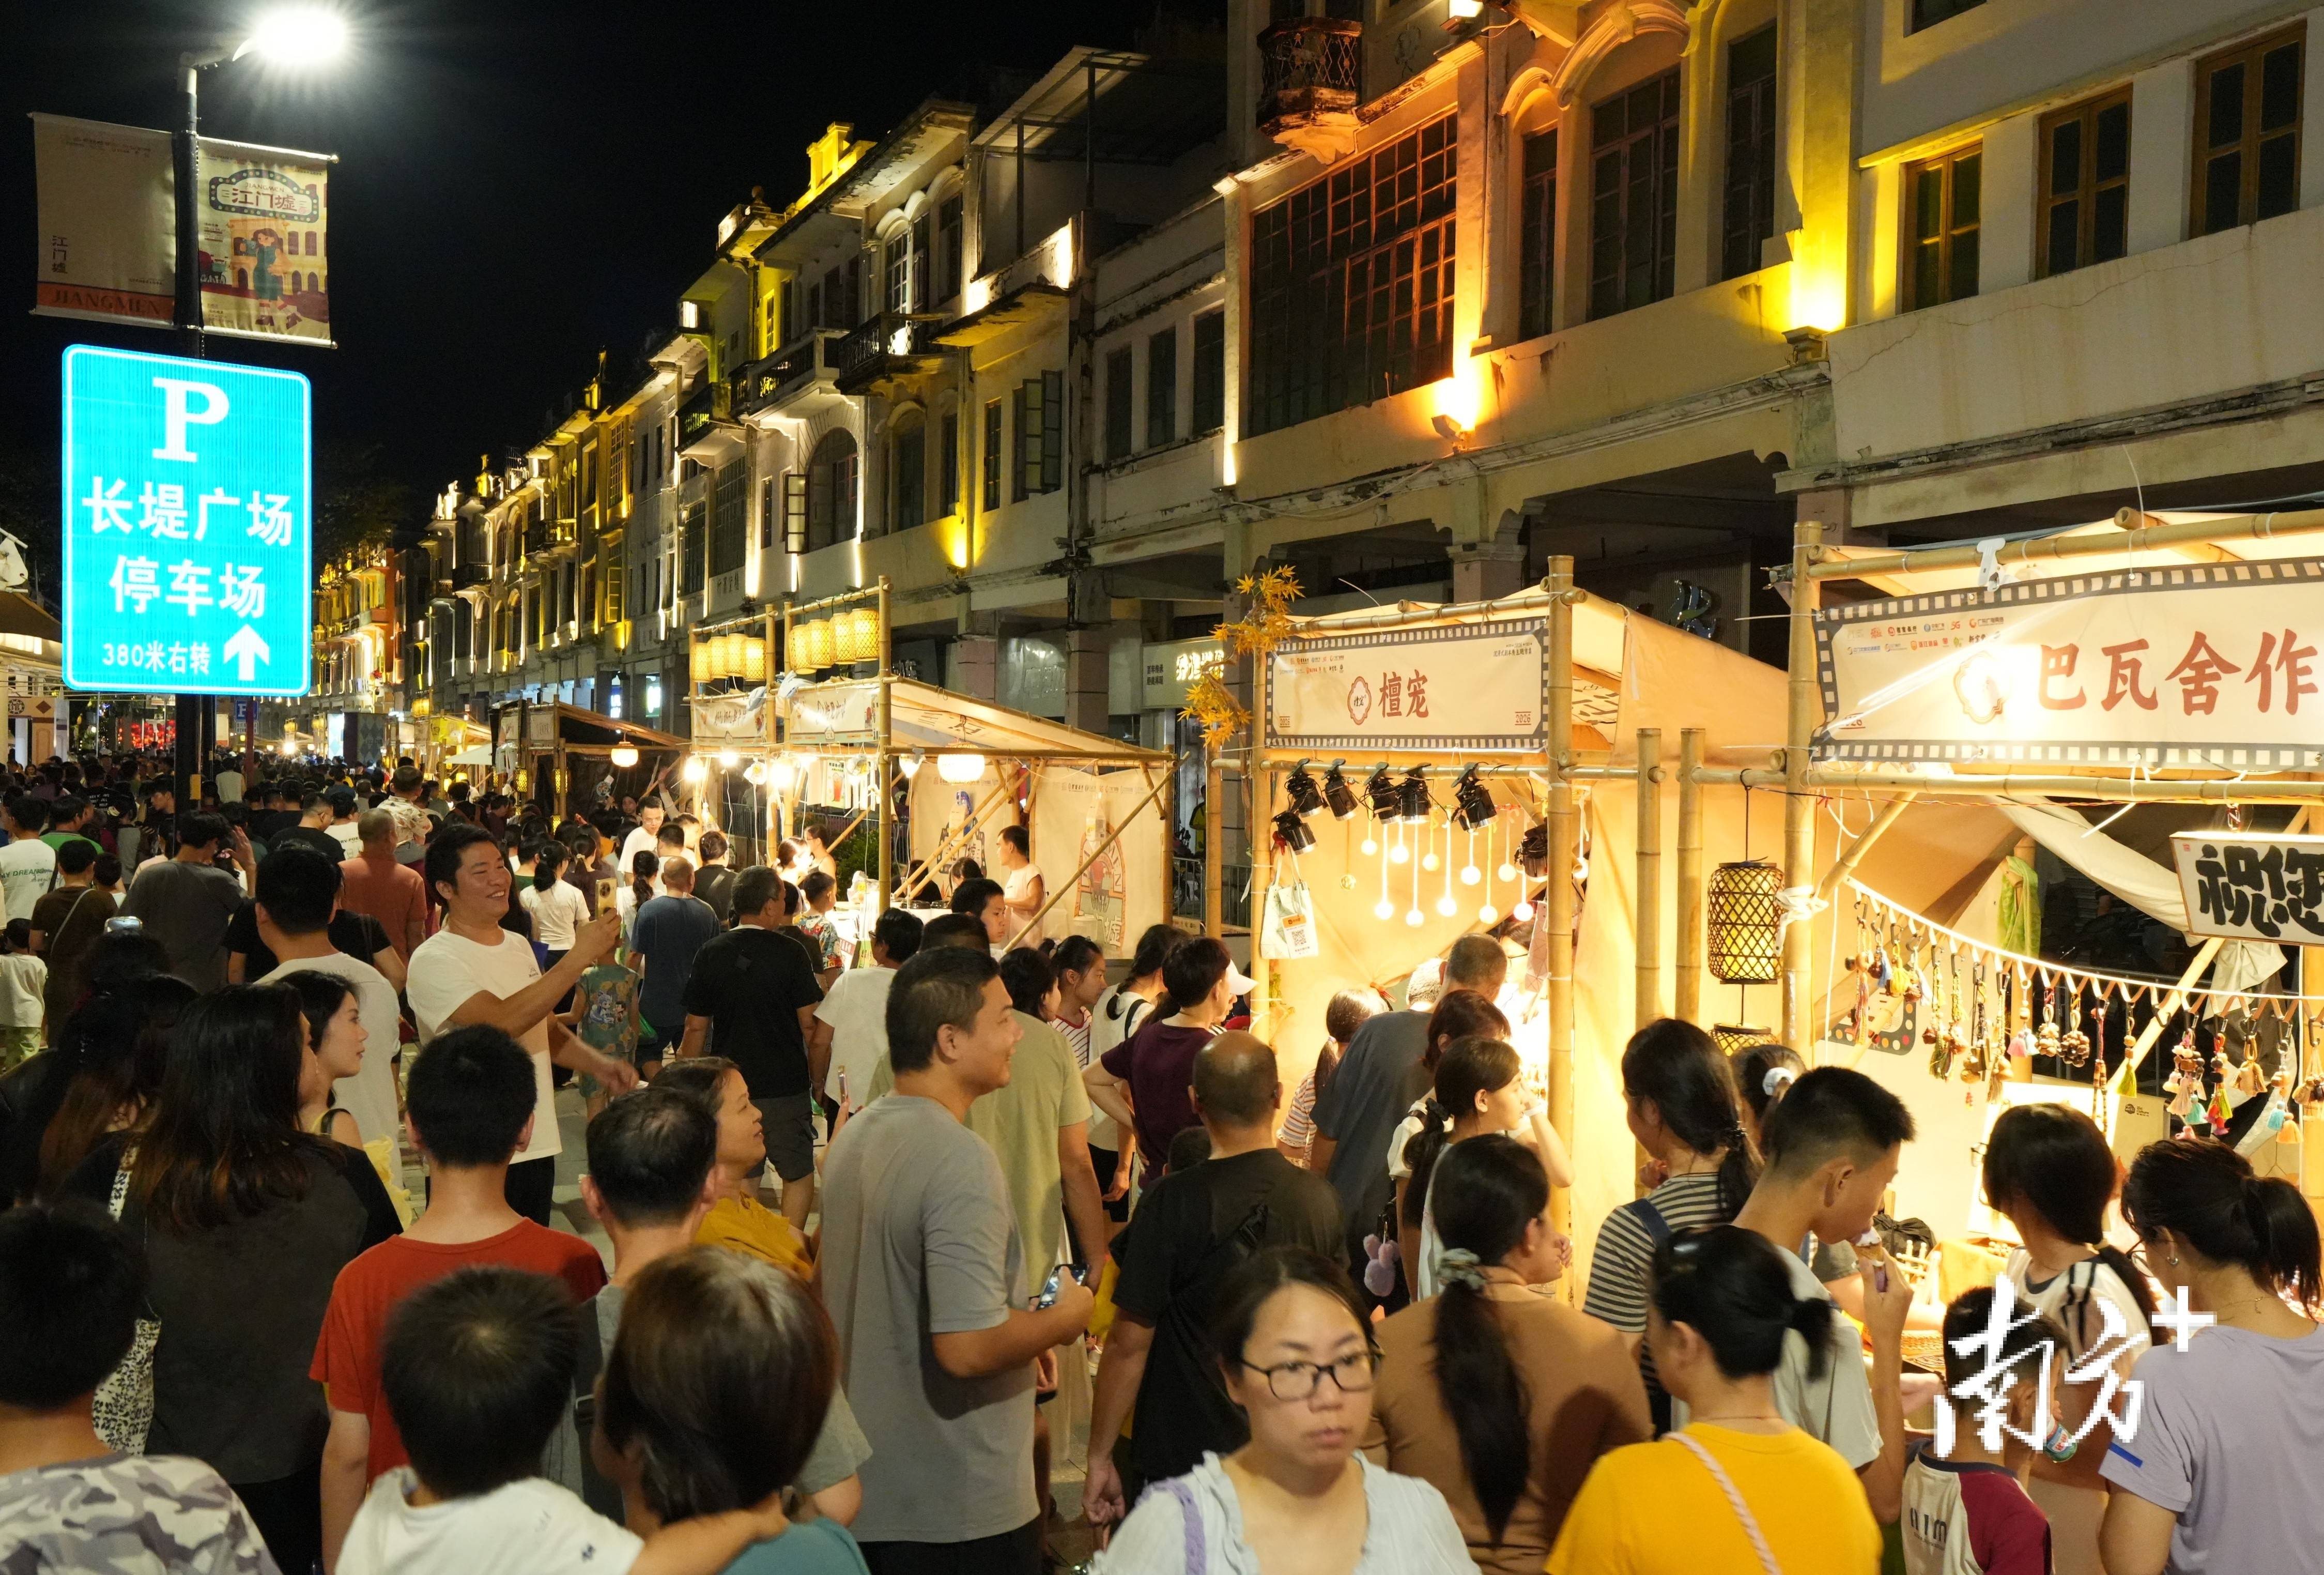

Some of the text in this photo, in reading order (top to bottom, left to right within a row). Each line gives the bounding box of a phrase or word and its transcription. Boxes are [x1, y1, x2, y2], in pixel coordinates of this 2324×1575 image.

[231, 188, 298, 212] 江门墟
[245, 181, 285, 193] JIANGMEN
[52, 235, 68, 274] 江门墟
[152, 377, 230, 463] P
[82, 476, 294, 546] 长堤广场
[109, 554, 267, 619] 停车场
[102, 640, 212, 676] 380米右转
[2038, 629, 2318, 716] 巴瓦舍作
[1378, 669, 1429, 718] 檀宠
[1515, 714, 1531, 723] 2026
[2195, 844, 2324, 938] 祝您
